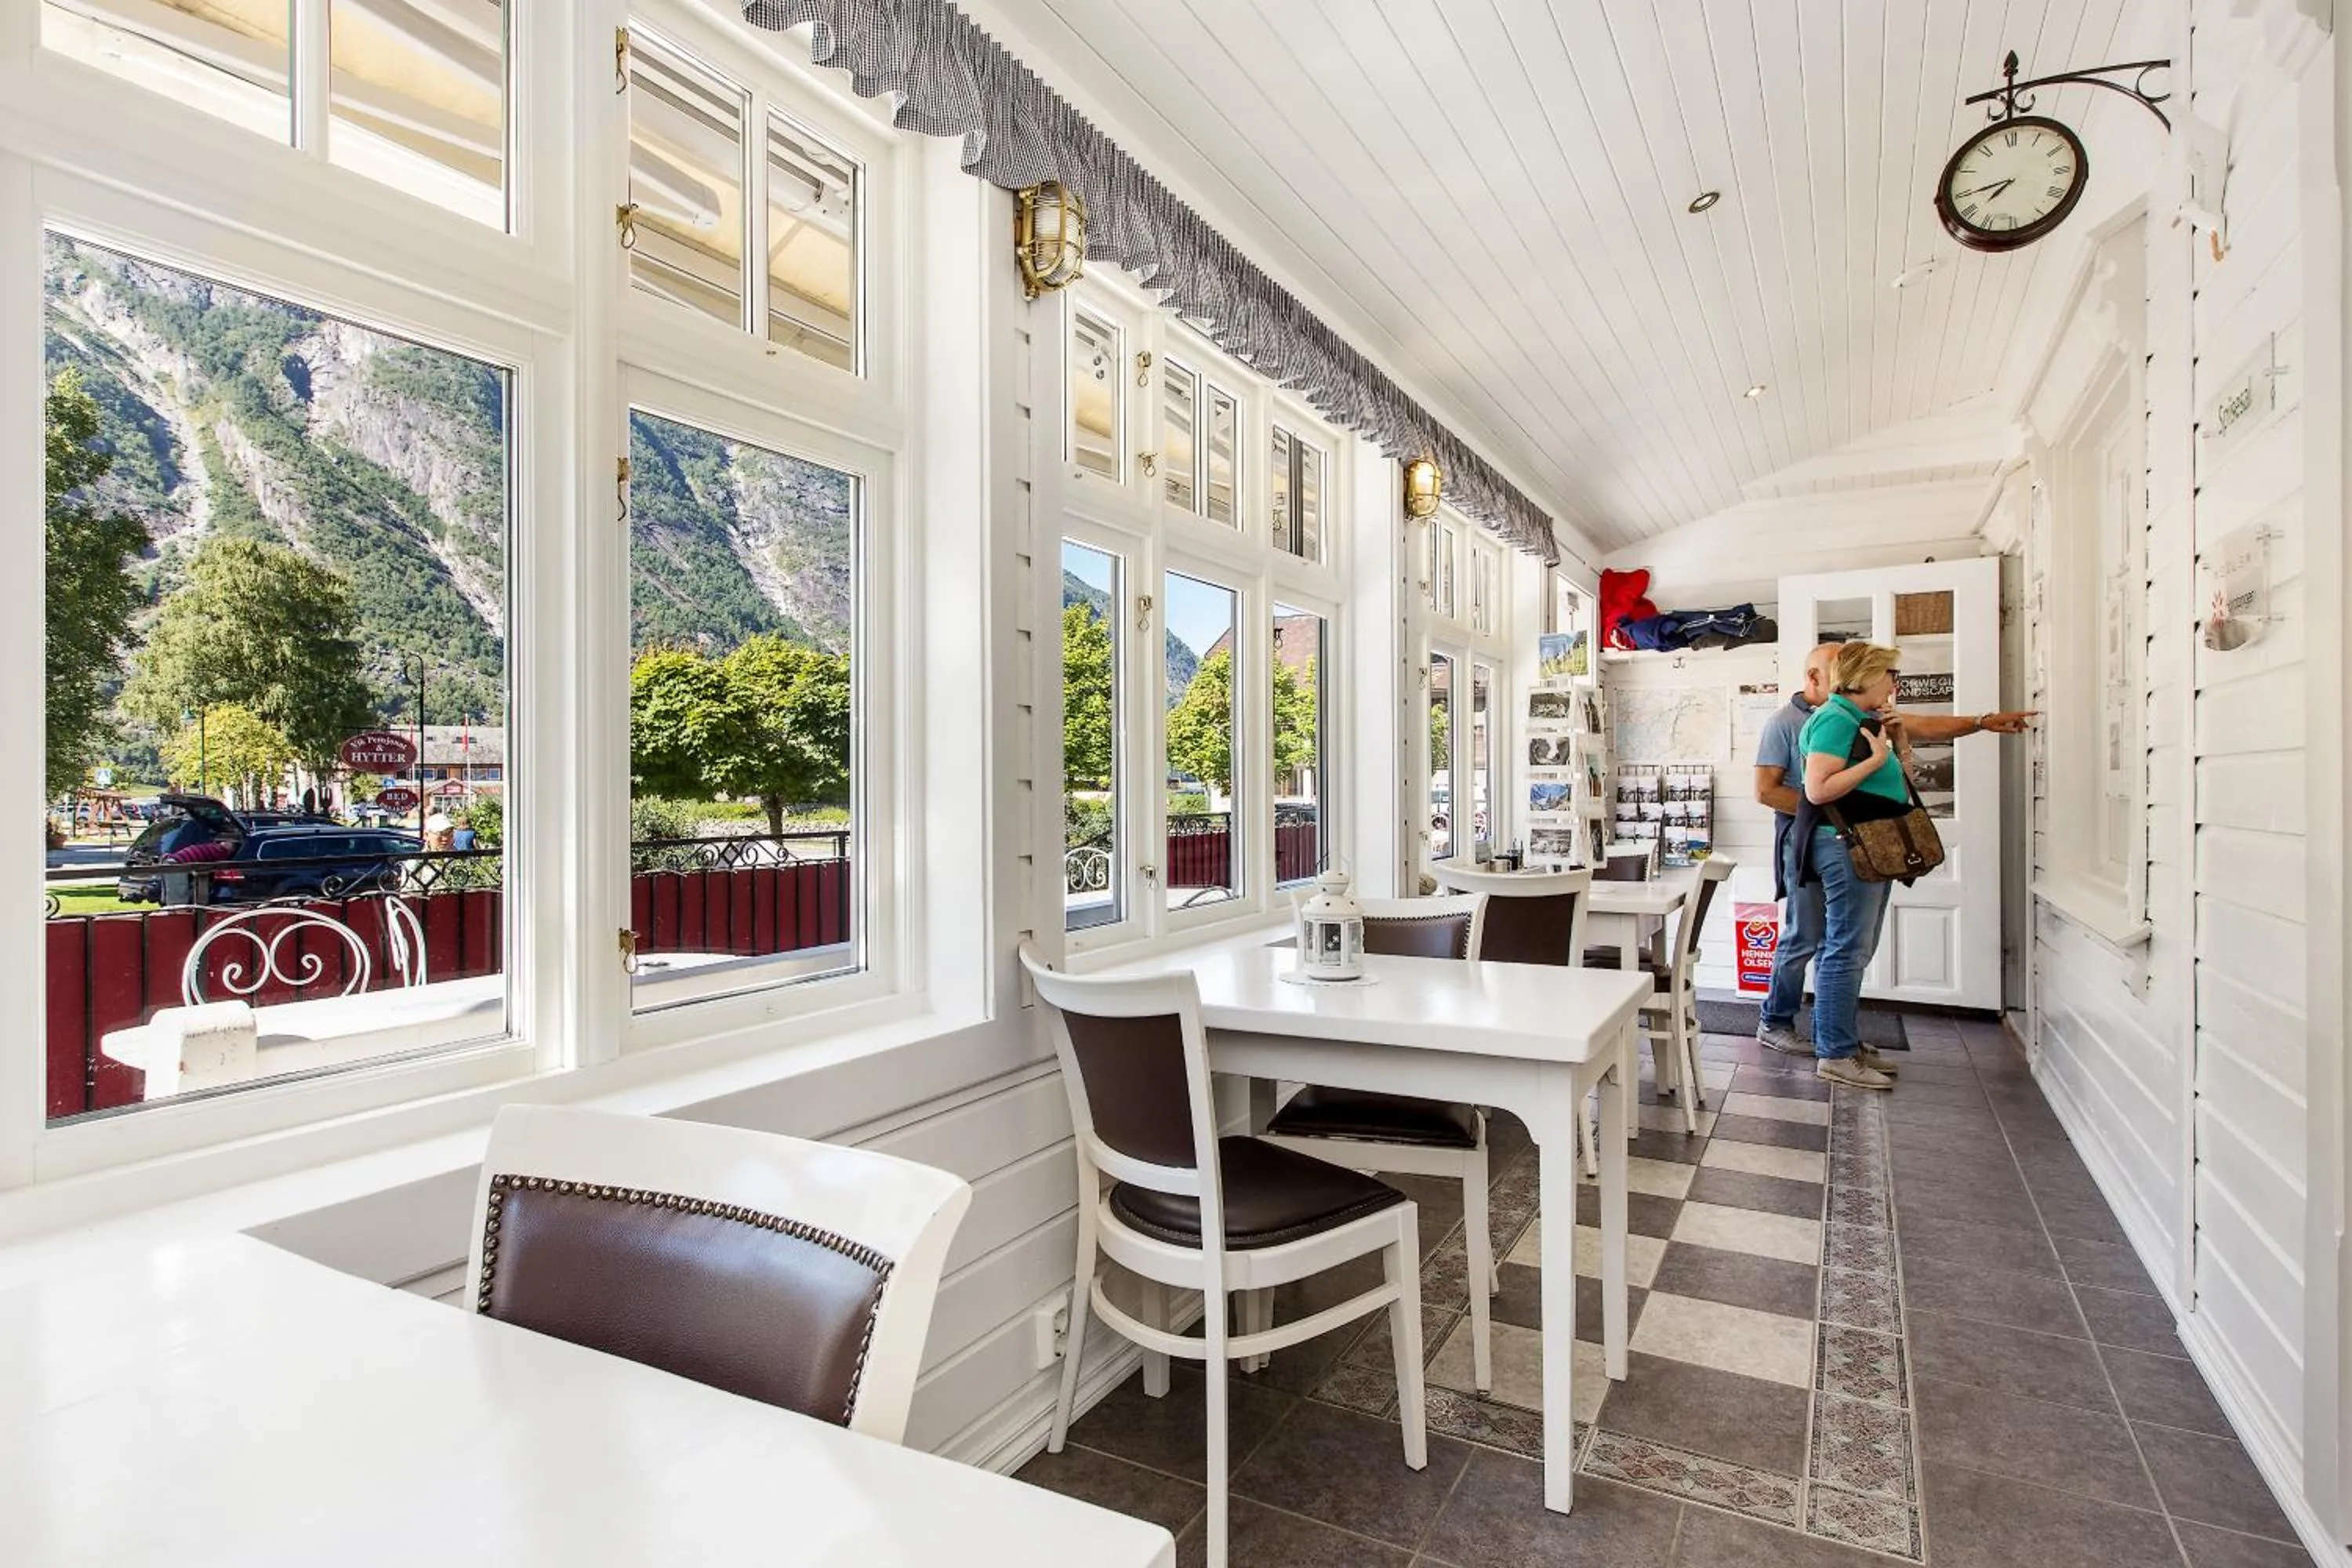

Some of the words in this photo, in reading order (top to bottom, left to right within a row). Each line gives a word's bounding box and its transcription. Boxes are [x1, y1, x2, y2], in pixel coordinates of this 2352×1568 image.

[1897, 677, 1954, 689] ORWEGI
[1897, 687, 1954, 697] ANDSCAP
[351, 752, 406, 763] HYTTER
